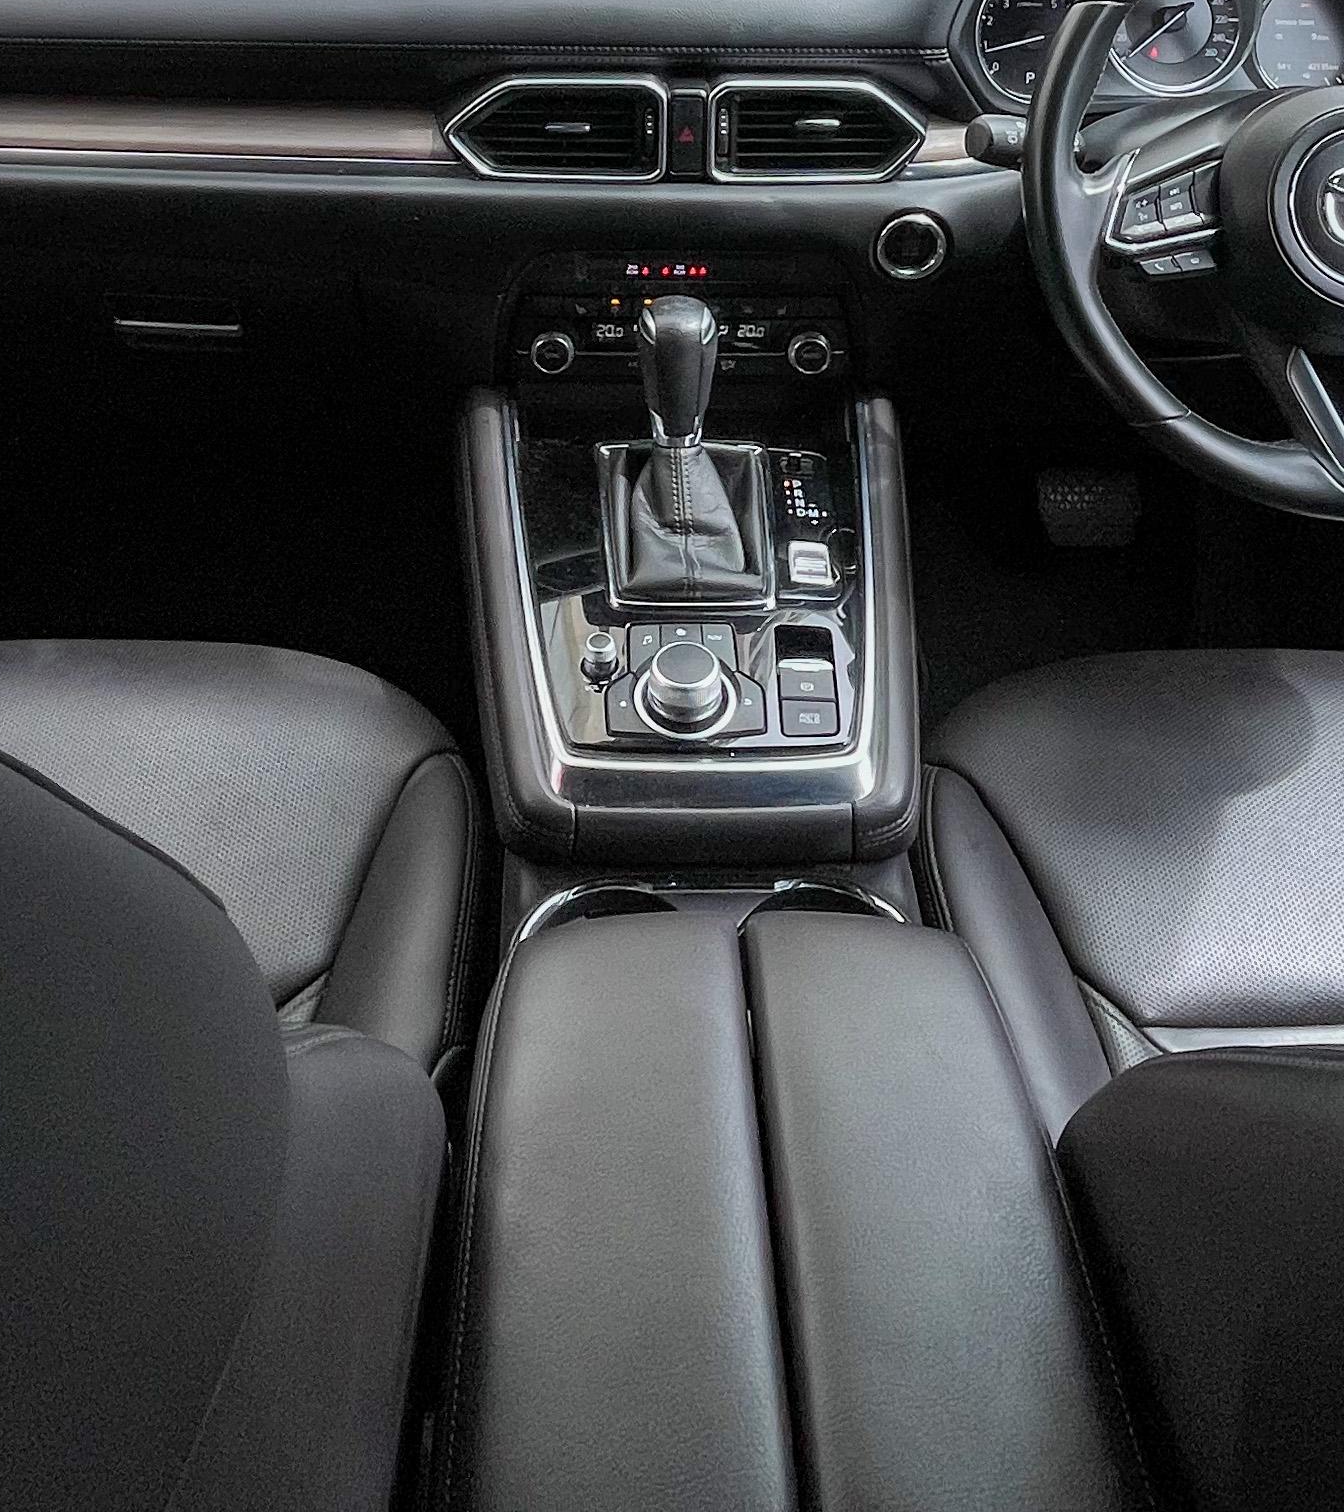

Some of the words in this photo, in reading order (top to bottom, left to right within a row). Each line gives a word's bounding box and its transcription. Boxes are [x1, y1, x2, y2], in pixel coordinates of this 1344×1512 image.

[1003, 0, 1010, 9] 3
[986, 16, 994, 26] 2
[1026, 71, 1036, 84] P
